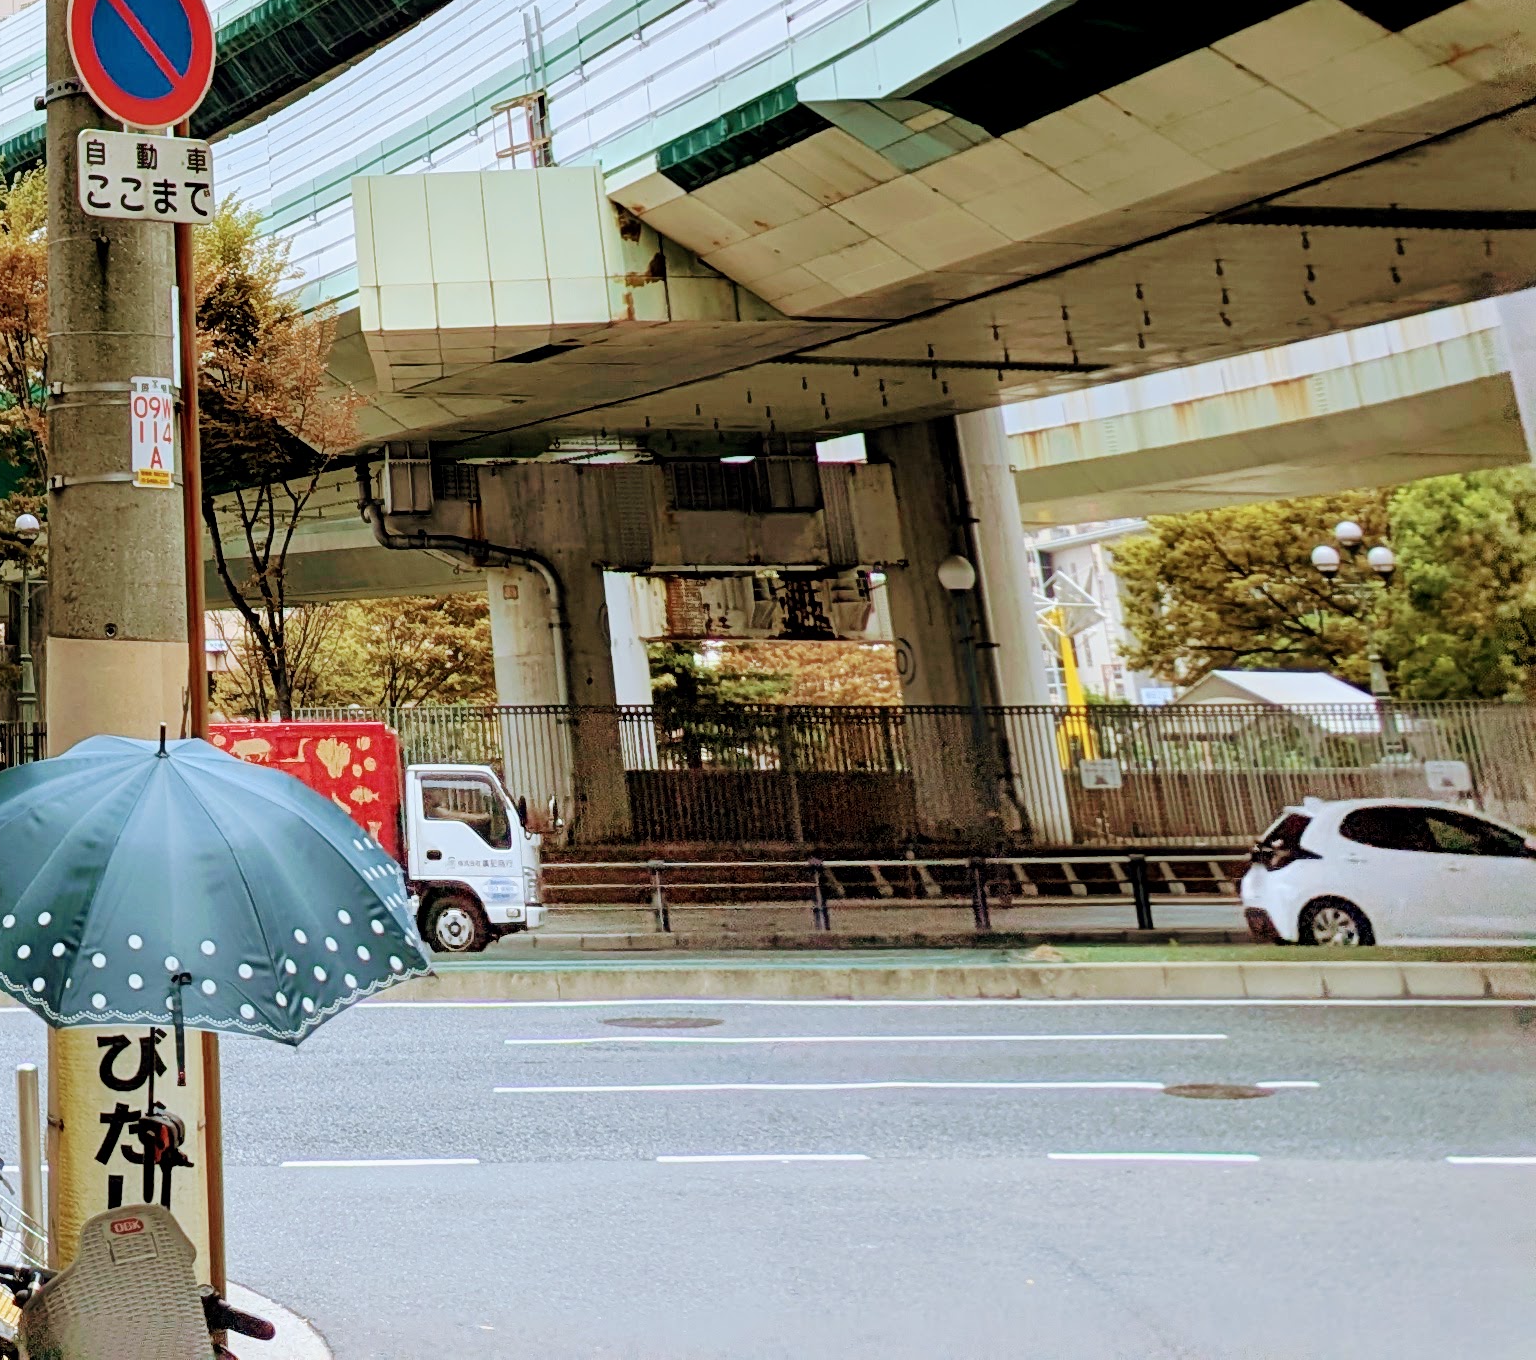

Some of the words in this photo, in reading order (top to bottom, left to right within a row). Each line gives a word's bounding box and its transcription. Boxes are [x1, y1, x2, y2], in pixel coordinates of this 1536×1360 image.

[86, 139, 207, 174] 自動車
[87, 174, 210, 217] ここまで
[140, 421, 172, 444] 114
[151, 446, 163, 469] A
